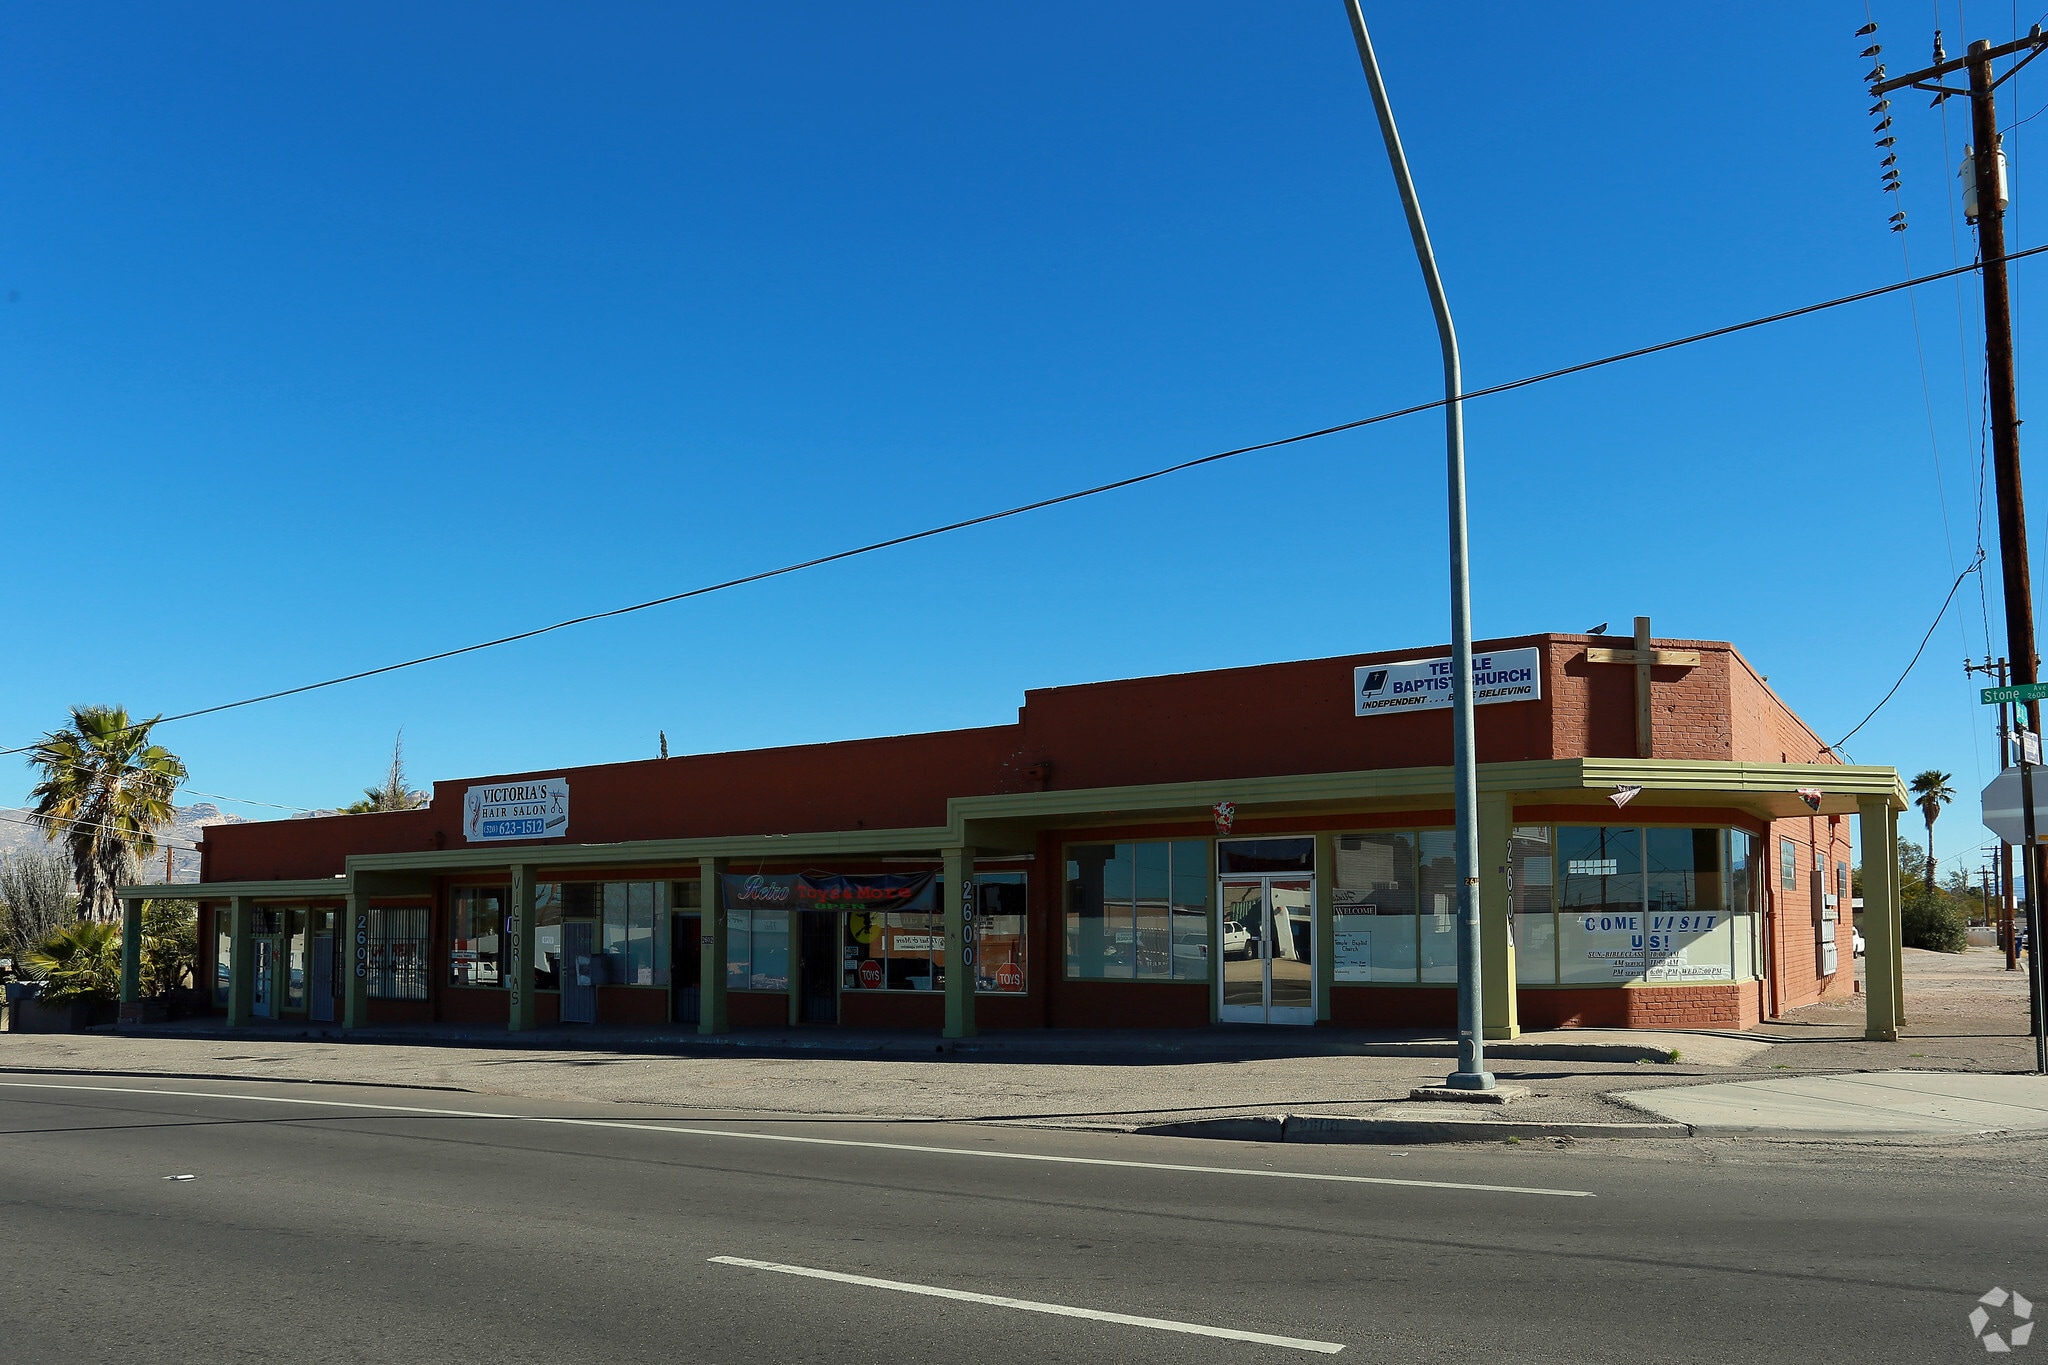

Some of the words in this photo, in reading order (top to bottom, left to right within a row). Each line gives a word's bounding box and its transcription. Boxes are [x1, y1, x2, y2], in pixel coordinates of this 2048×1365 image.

[1429, 658, 1491, 675] TELE
[1472, 668, 1531, 686] HURCH
[1362, 695, 1427, 710] INDEPENDENT
[1479, 685, 1531, 698] BELIEVING
[1984, 690, 2020, 702] Stone
[2027, 691, 2046, 699] 2600
[483, 785, 547, 803] VICTORIA'S
[483, 807, 507, 818] HAIR
[513, 805, 547, 816] SALON
[484, 825, 498, 834] (520)
[499, 819, 543, 835] 623-1512
[737, 874, 790, 900] Retro
[797, 885, 840, 902] Toys
[857, 886, 912, 900] More
[1335, 906, 1375, 916] WELCOME
[962, 880, 973, 967] 2600
[1585, 917, 1638, 931] COME
[1652, 916, 1716, 932] VISIT
[356, 915, 367, 977] 2606
[512, 876, 520, 1005] VICTORIAS
[1632, 935, 1669, 951] US!
[862, 969, 880, 981] TOYS
[1000, 973, 1020, 985] TOYS
